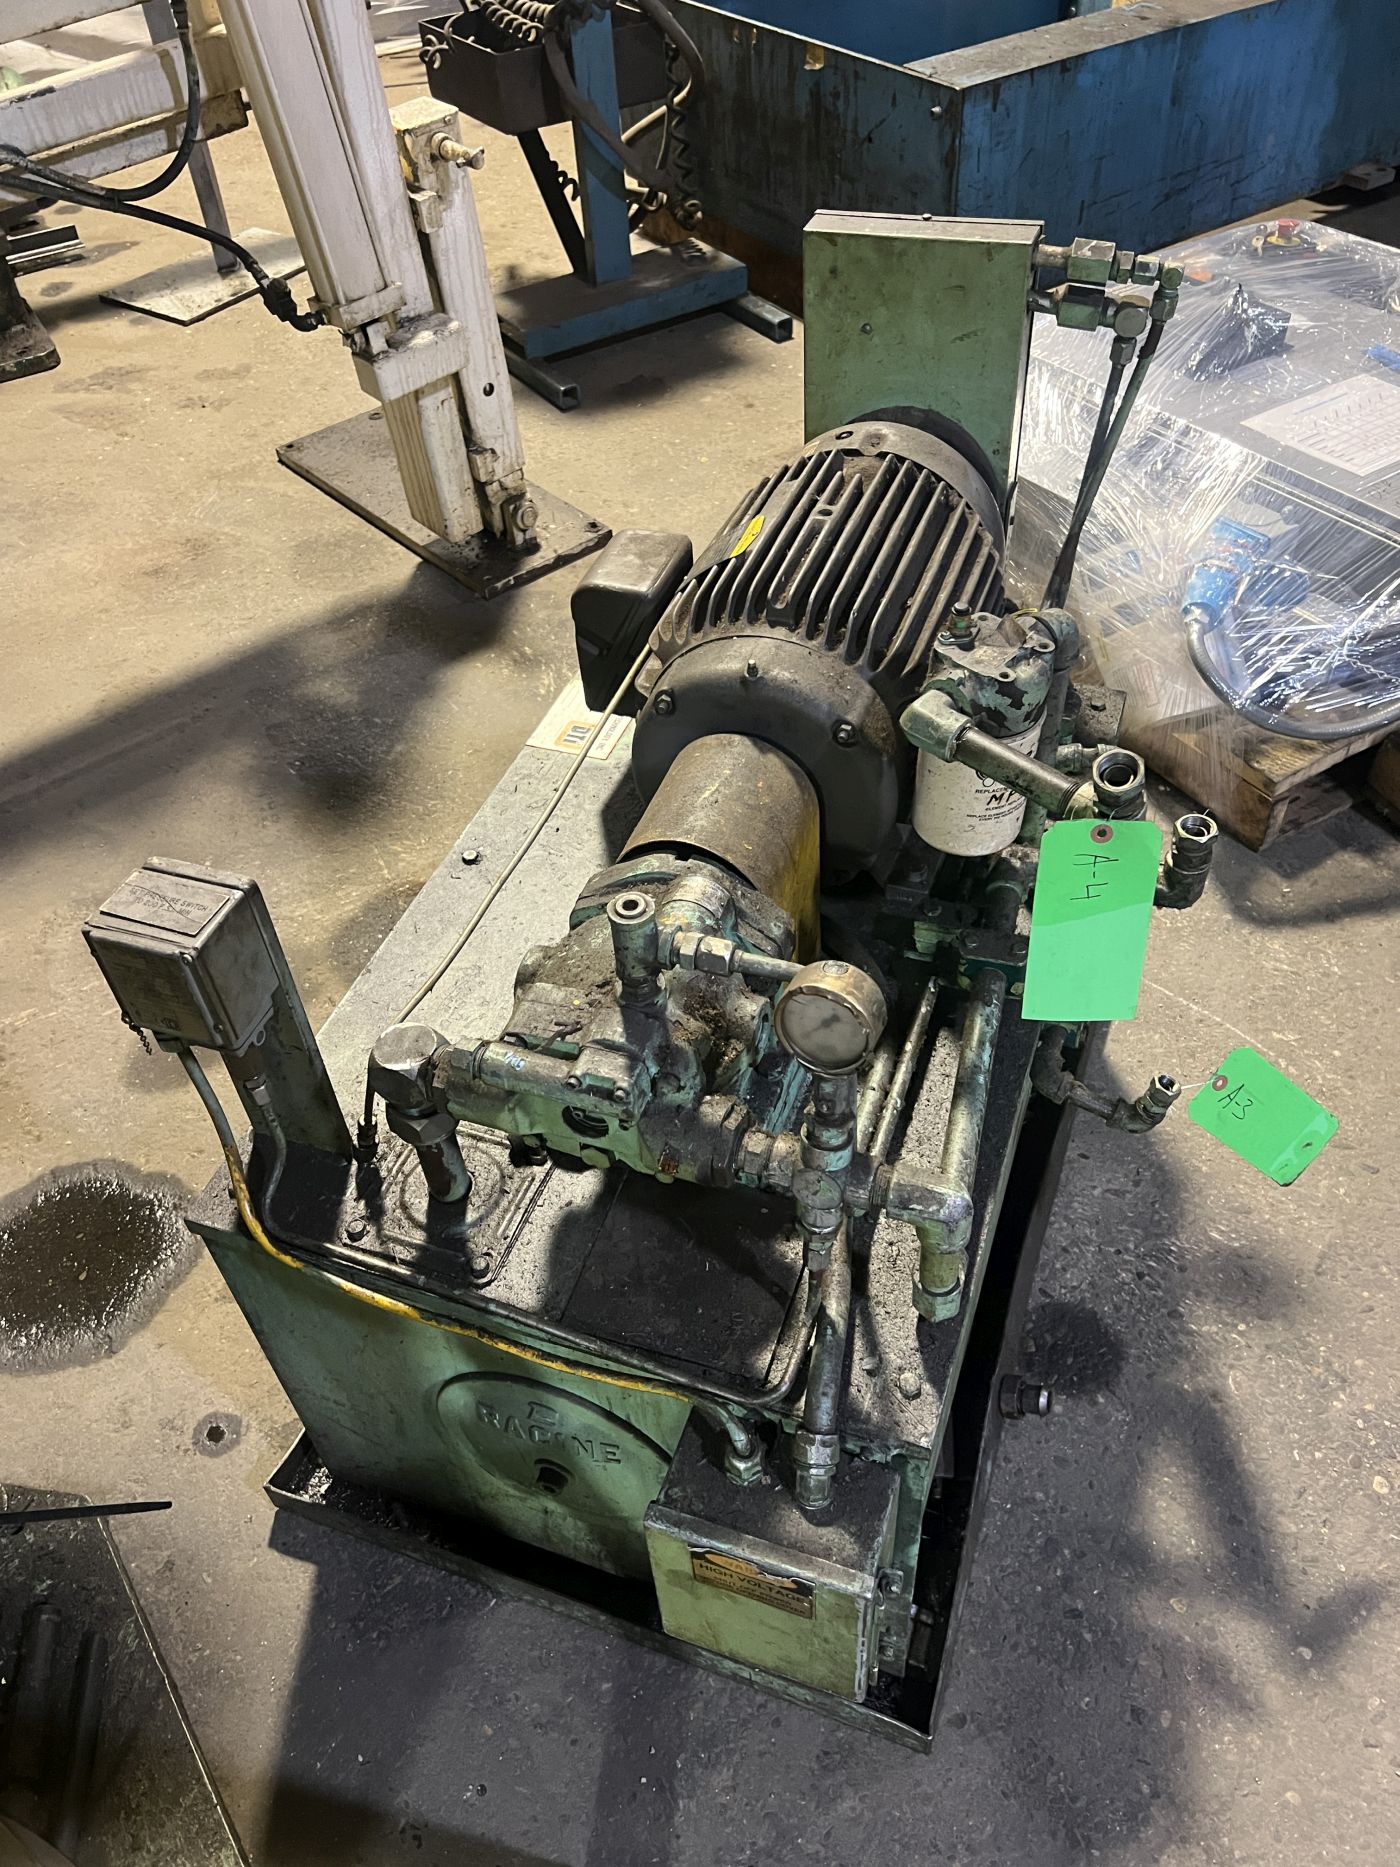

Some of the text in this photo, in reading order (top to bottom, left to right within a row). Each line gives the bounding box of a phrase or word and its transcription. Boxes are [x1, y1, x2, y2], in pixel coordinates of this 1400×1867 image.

[180, 899, 209, 912] SWITCH
[1217, 1083, 1254, 1121] A-3
[699, 1562, 734, 1580] HIGH
[736, 1574, 807, 1604] VOLTAGE
